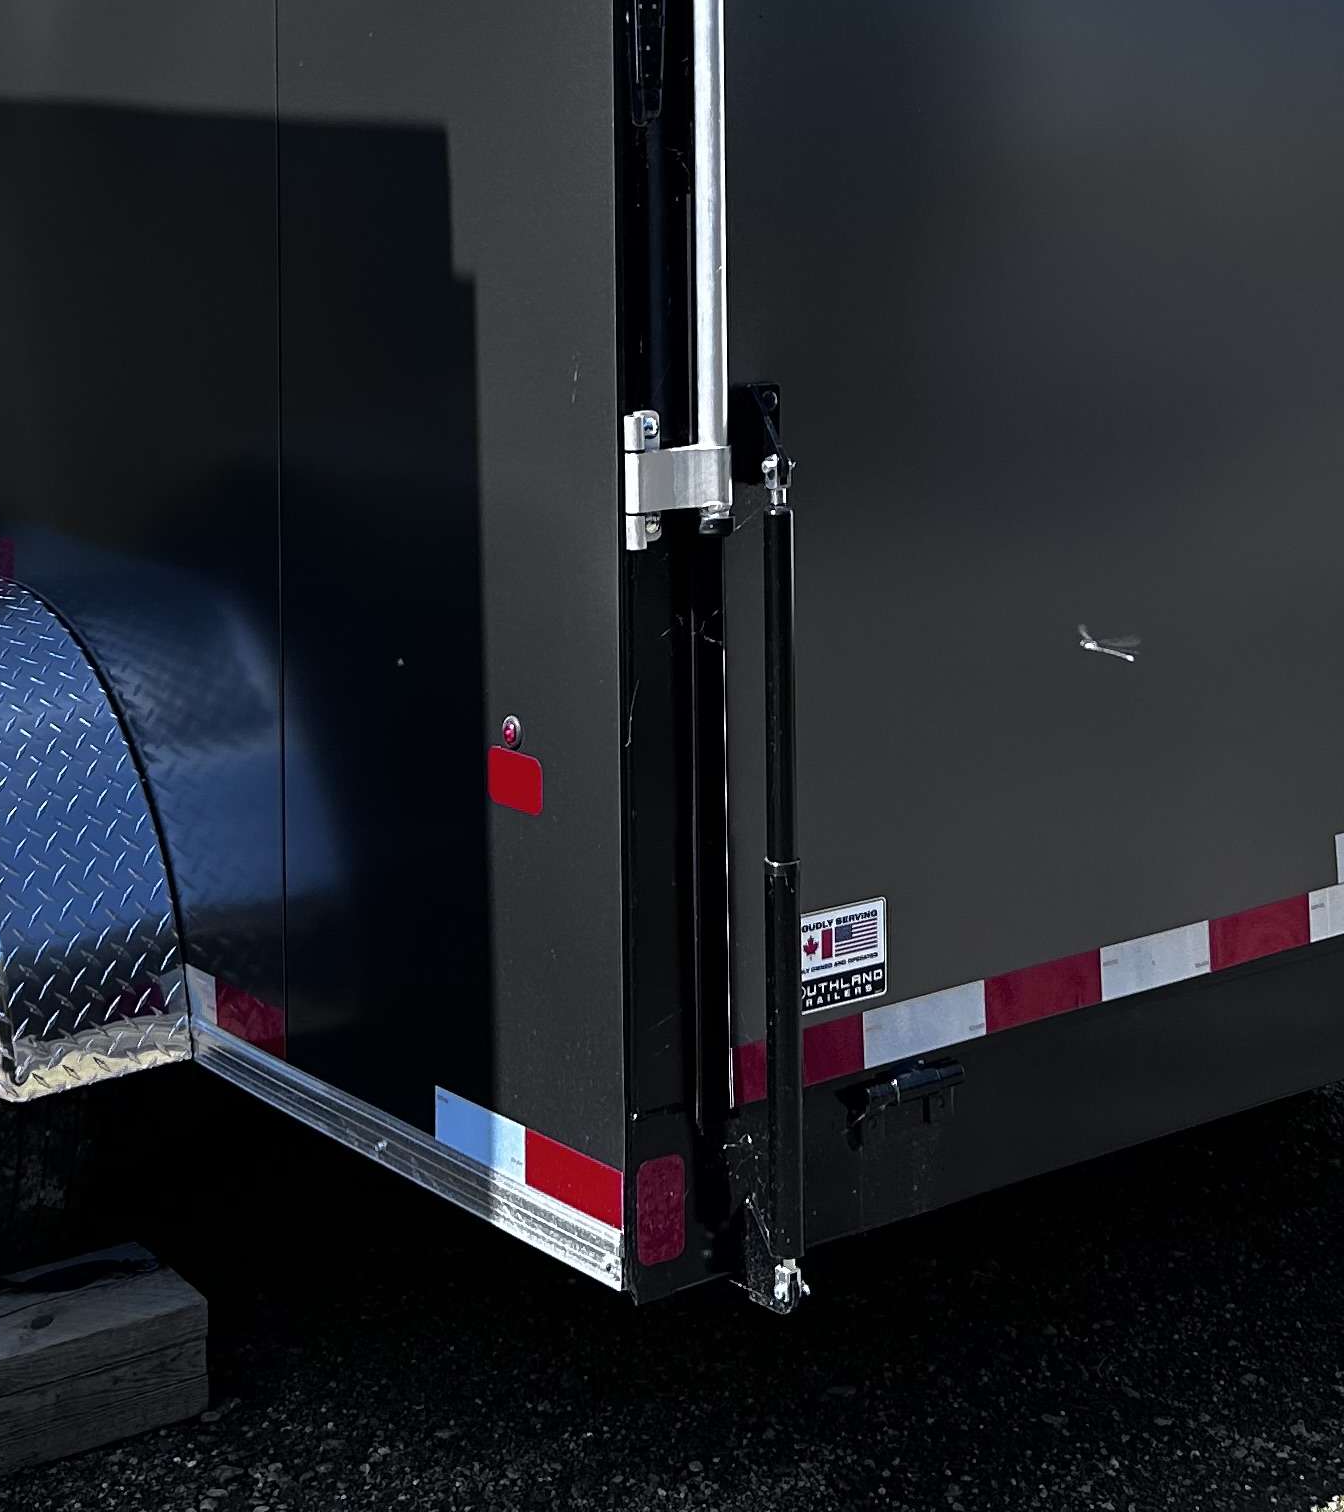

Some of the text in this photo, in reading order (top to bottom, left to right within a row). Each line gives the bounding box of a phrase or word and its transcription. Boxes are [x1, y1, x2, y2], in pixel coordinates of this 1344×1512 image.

[801, 909, 878, 933] OUDLY SERVING
[801, 968, 884, 999] UTHLAND
[805, 983, 873, 1008] RAILERS
